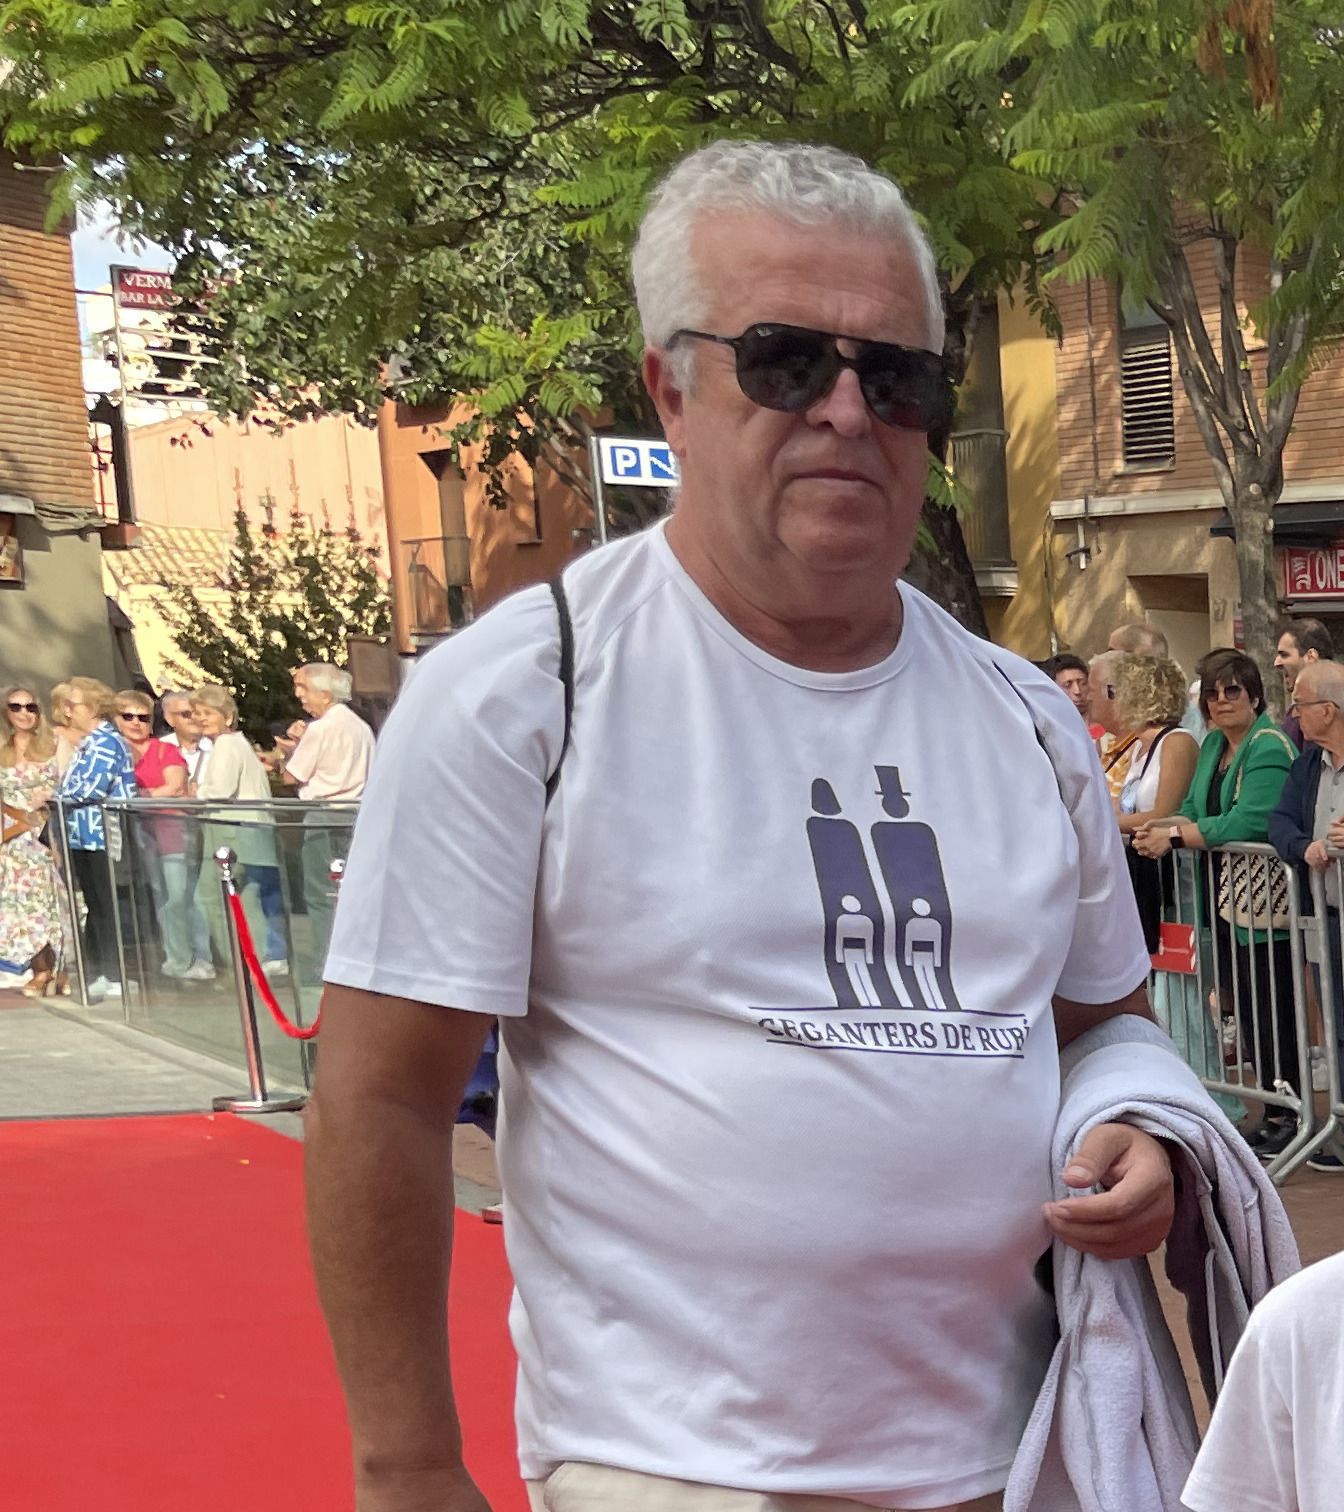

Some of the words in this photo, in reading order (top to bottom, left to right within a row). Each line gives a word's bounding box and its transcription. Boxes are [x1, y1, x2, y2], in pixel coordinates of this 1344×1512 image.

[123, 271, 173, 290] VERM
[615, 447, 637, 475] P
[940, 1022, 976, 1051] DE
